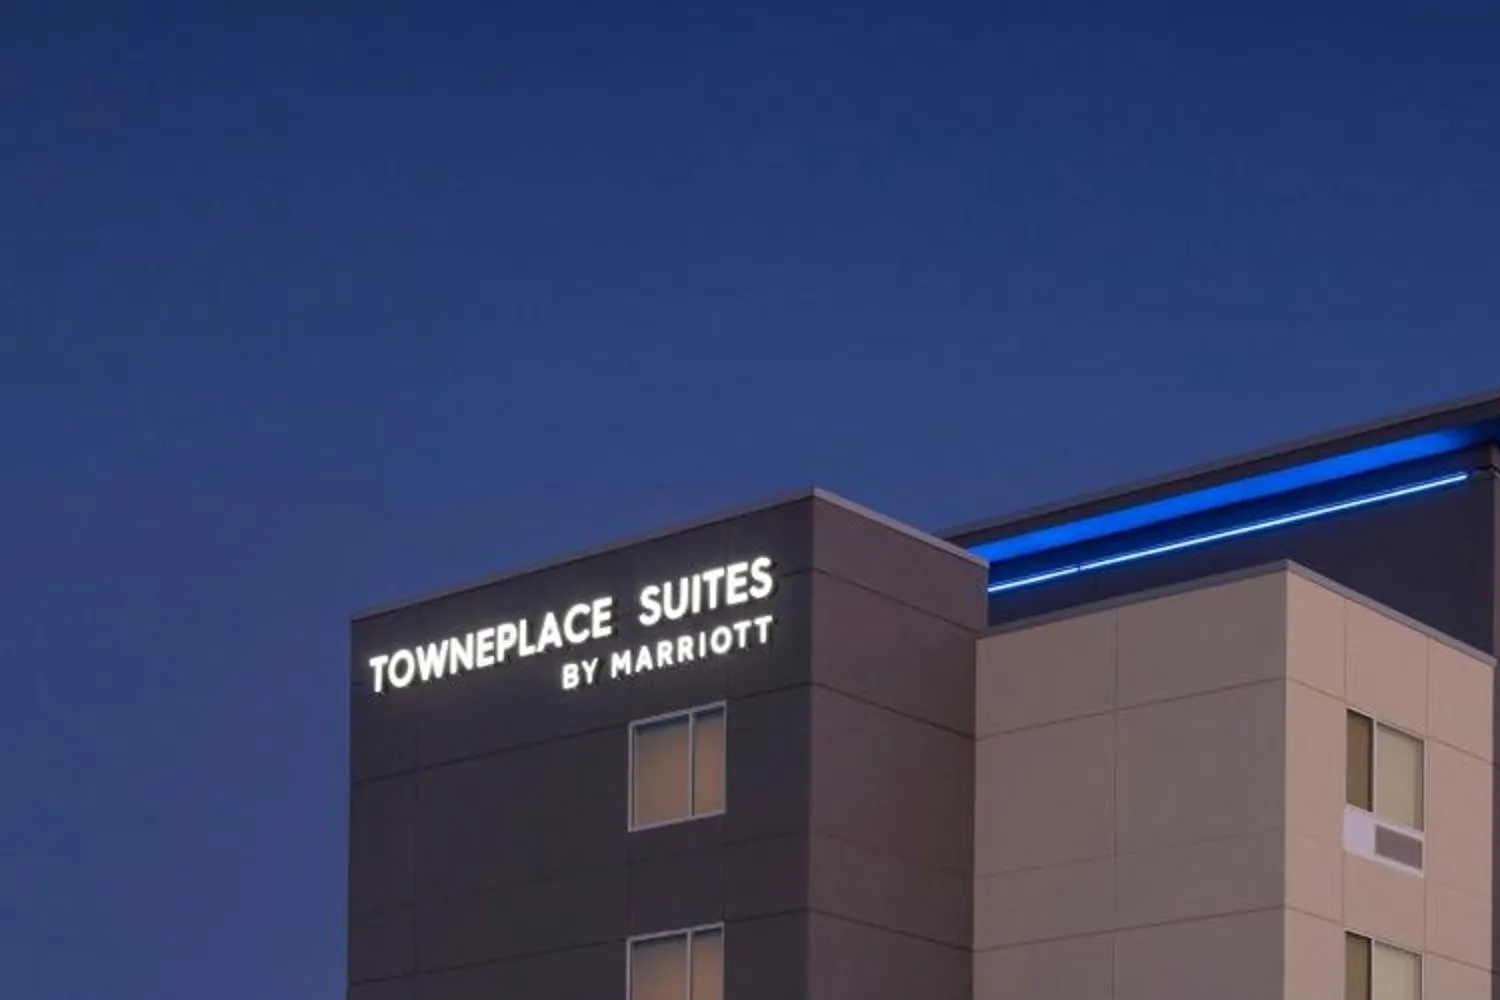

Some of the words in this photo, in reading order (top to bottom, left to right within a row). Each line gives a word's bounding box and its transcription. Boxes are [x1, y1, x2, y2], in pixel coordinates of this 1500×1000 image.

[368, 596, 613, 693] TOWNEPLACE
[638, 555, 773, 627] SUITES
[561, 657, 599, 690] BY
[610, 614, 774, 679] MARRIOTT
